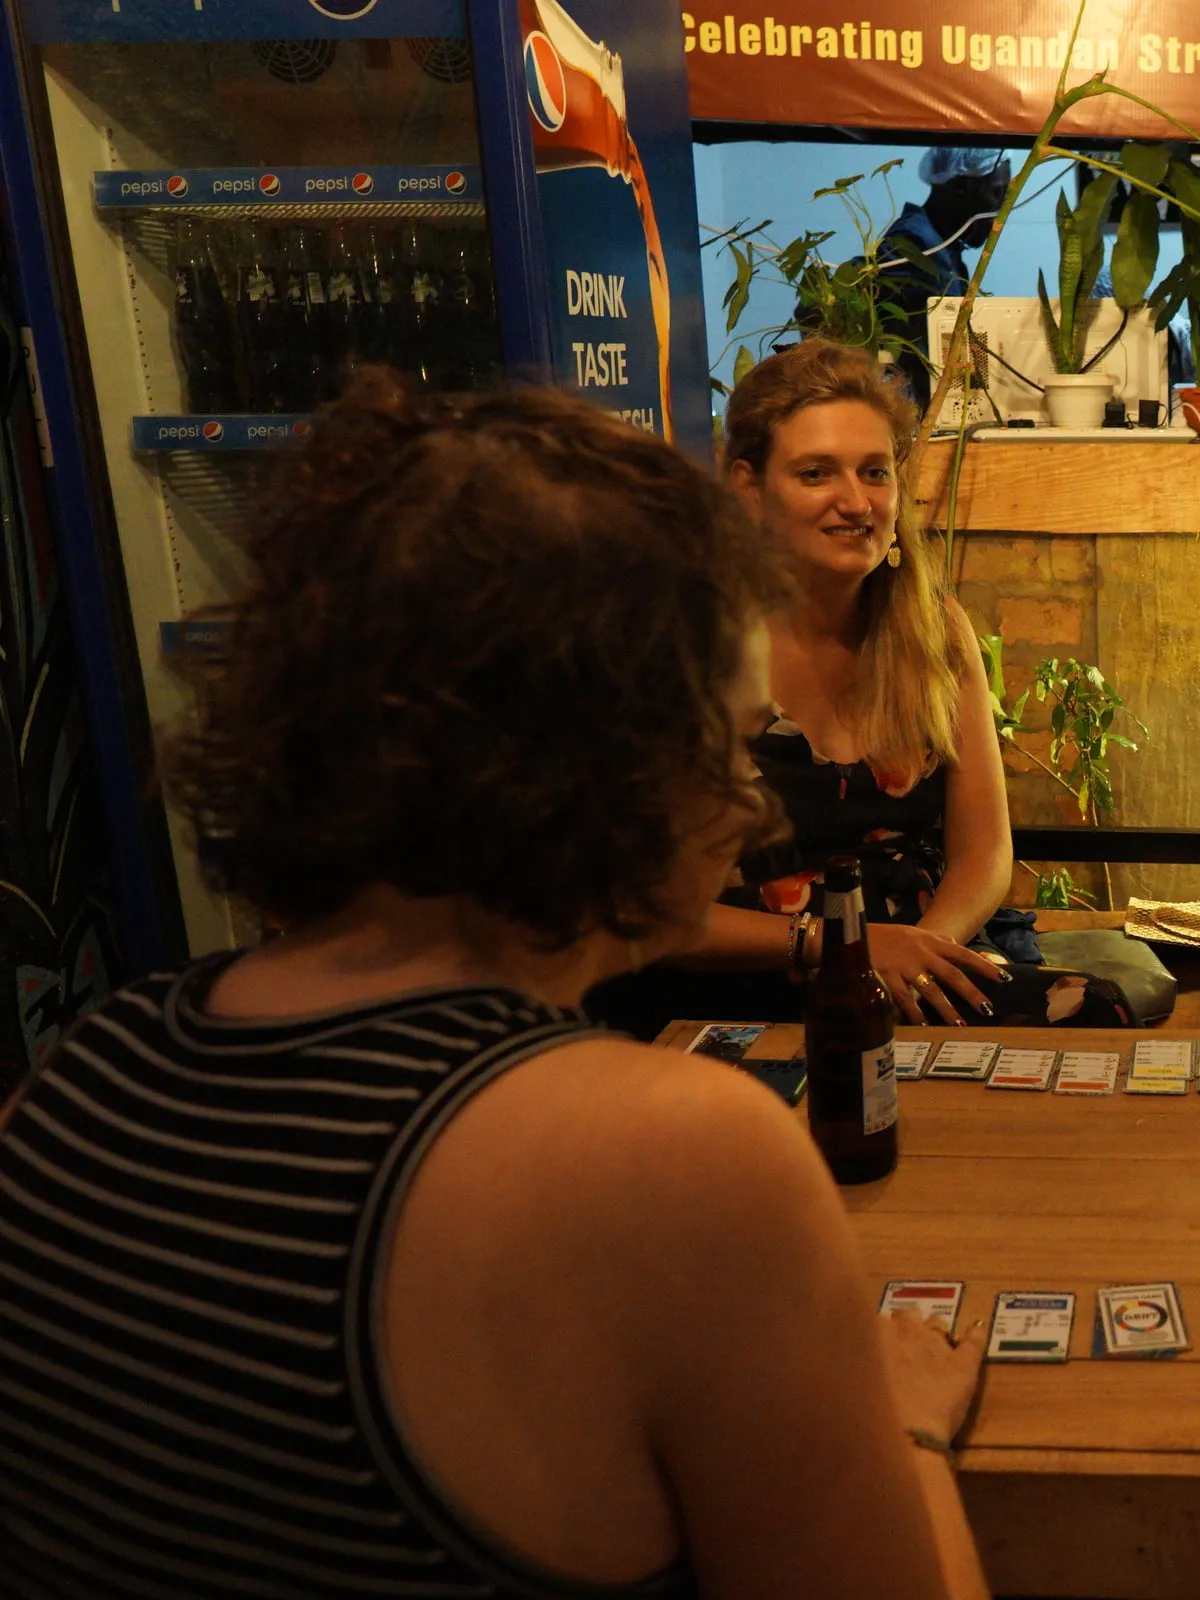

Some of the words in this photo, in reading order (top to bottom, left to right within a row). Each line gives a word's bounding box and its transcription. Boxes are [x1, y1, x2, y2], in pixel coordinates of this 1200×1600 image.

[682, 12, 923, 68] Celebrating
[941, 24, 1119, 71] Ugandan
[121, 180, 163, 196] pepsi
[213, 177, 256, 194] pepsi
[305, 176, 348, 193] pepsi
[398, 175, 441, 193] pepsi
[566, 270, 627, 318] DRINK
[572, 343, 629, 387] TASTE
[159, 425, 199, 440] pepsi
[247, 424, 288, 439] pepsi
